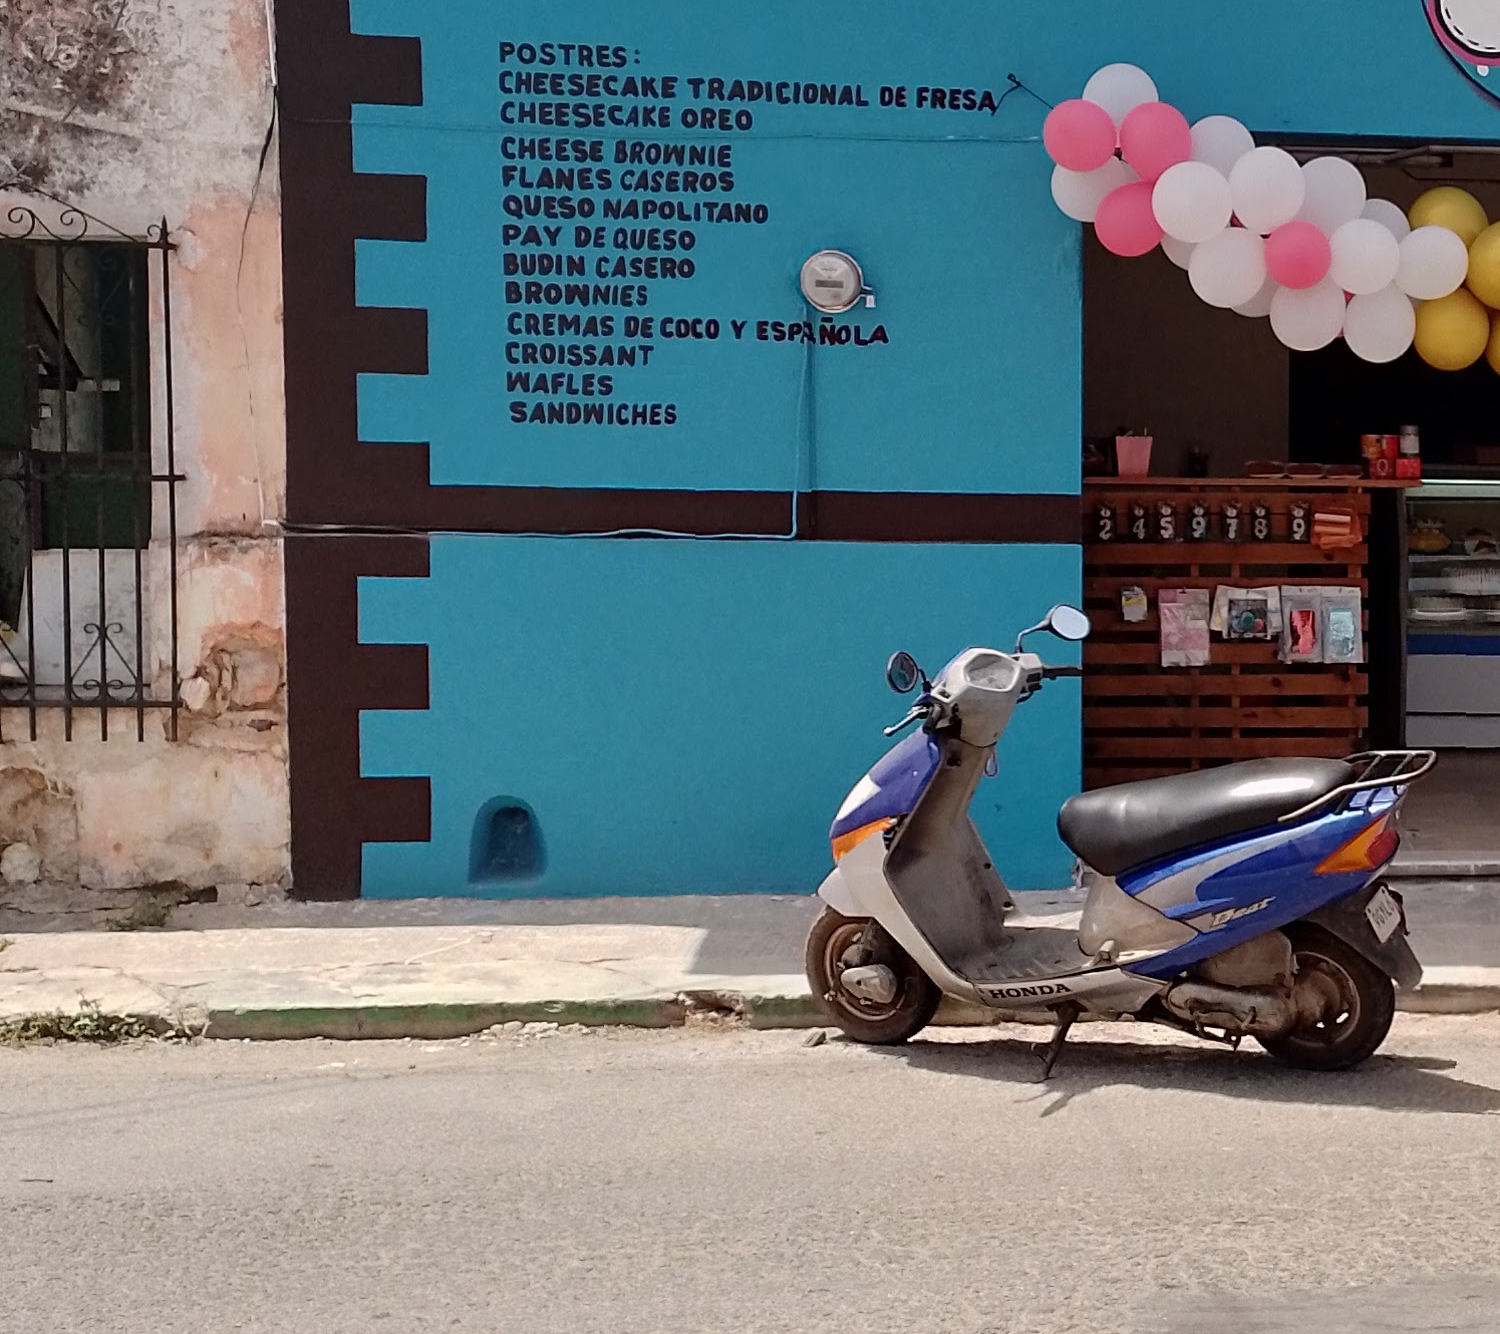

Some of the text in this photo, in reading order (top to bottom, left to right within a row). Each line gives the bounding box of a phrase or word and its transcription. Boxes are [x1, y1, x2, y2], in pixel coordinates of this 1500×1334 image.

[498, 70, 997, 112] CHEESECAKE TRADICIONAL DE FRESA
[500, 102, 753, 131] CHEESECAKE OREO
[500, 136, 732, 168] CHEESE BROWNIE
[501, 165, 735, 194] FLANES CASEROS
[502, 194, 769, 225] QUESO NAPOLITANO
[502, 224, 696, 252] PAY DE QUESO
[503, 252, 696, 280] BUDIN CASERO
[505, 280, 648, 306] BROWNIES
[507, 311, 890, 346] CREMAS DE COCO Y ESPAÑOLA
[505, 341, 655, 367] CROISSANT
[506, 371, 614, 397] WAFLES
[509, 401, 677, 426] SANDWICHES
[989, 983, 1072, 999] HONDA
